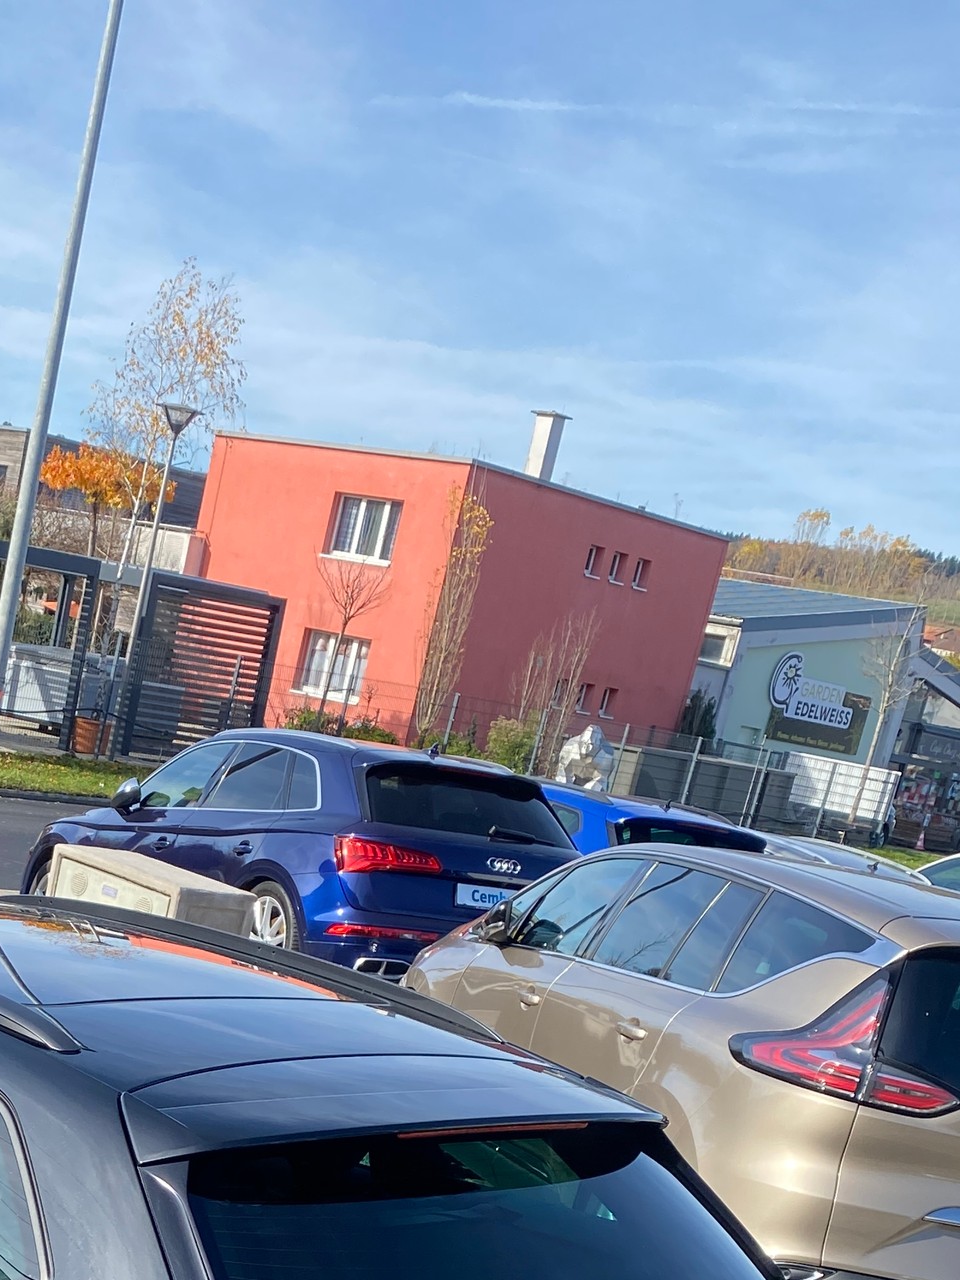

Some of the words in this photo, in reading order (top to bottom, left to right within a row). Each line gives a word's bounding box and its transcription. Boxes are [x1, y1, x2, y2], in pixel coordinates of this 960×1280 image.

[800, 681, 845, 703] GARDEN
[794, 701, 851, 726] EDELWEISS
[471, 889, 506, 904] Cemb
